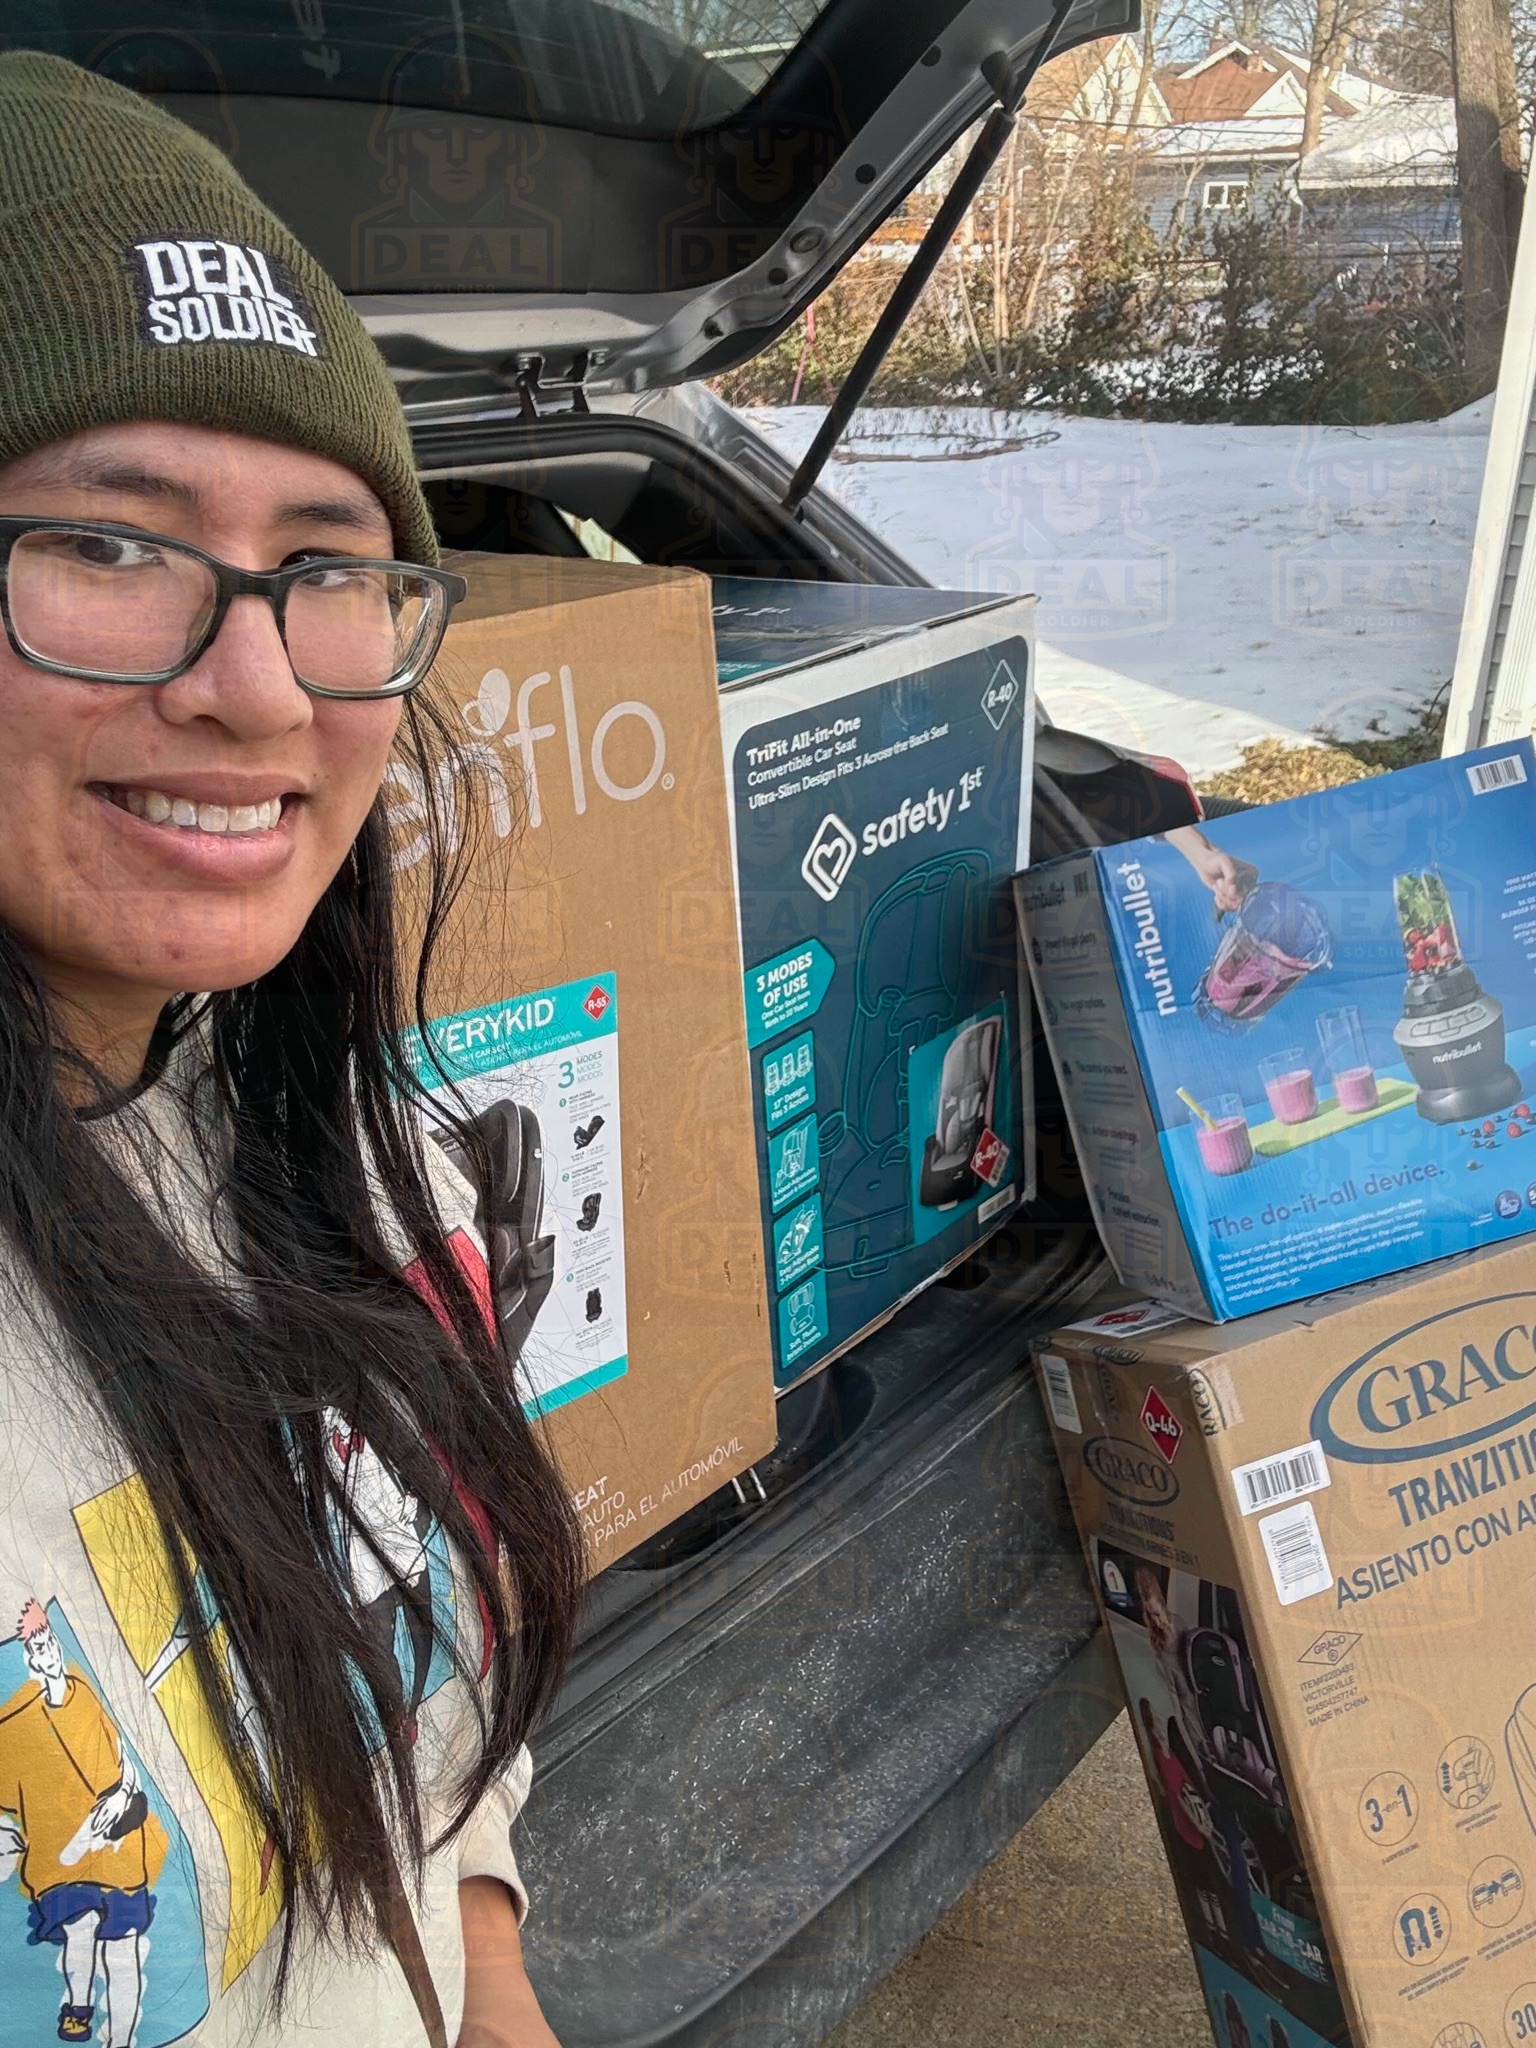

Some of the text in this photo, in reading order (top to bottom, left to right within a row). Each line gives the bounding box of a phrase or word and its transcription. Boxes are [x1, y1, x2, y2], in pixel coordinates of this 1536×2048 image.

[134, 241, 293, 309] DEAL
[148, 295, 317, 356] SOLDIER
[987, 682, 1013, 708] R-40
[746, 716, 861, 766] TriFit All-in-One
[748, 737, 857, 786] Convertible Car Seat
[748, 722, 949, 809] Ultra-Slim Design Fits 3 Across the Back Seat
[862, 766, 983, 856] safety 1st
[1116, 860, 1178, 1017] nutribullet
[756, 951, 813, 992] 3 MODES
[763, 972, 808, 1008] OF USE
[587, 997, 607, 1013] R-55
[761, 1009, 774, 1020] One
[774, 1004, 784, 1013] Car
[784, 997, 797, 1008] Seat
[557, 1051, 603, 1090] 3 MODES
[577, 1061, 601, 1075] MODES
[1432, 1041, 1482, 1064] nutribullet
[577, 1071, 604, 1084] MODOS
[1208, 1163, 1444, 1239] The do-it-all device.
[1357, 1323, 1536, 1434] GRAC
[1145, 1411, 1177, 1437] Q-46
[1096, 1447, 1168, 1492] GRACO
[572, 1476, 608, 1513] EAT
[582, 1491, 625, 1532] AUTO
[594, 1436, 744, 1548] PARA EL AUTOMÓVIL
[1335, 1532, 1452, 1609] ASIENTO
[1454, 1507, 1512, 1555] CON
[1109, 1570, 1119, 1591] 1
[1313, 1635, 1346, 1655] GRACO
[1303, 1675, 1356, 1703] VICTORVILLE
[1309, 1695, 1370, 1726] MADE IN CHINA
[1511, 2002, 1536, 2040] 30
